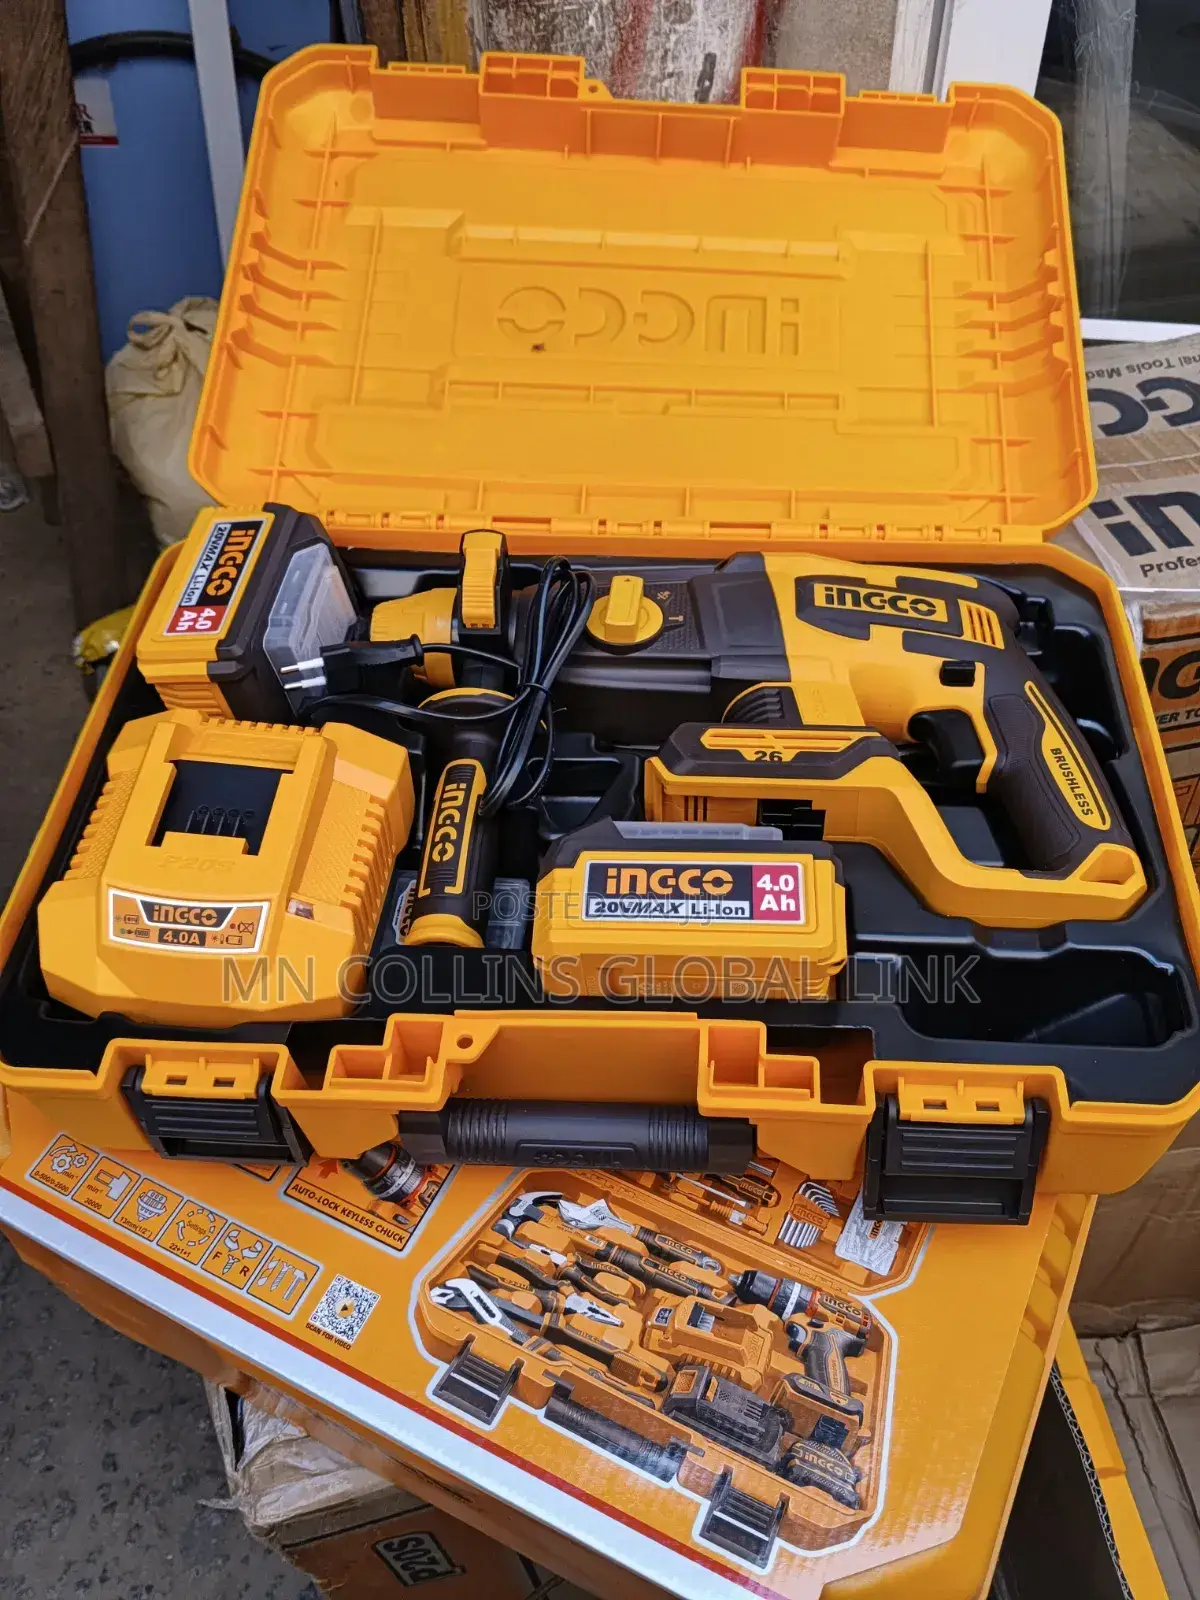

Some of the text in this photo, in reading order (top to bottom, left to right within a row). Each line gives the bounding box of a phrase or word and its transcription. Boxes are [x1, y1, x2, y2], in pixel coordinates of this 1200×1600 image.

[1085, 354, 1200, 380] nal Tools Mad
[1140, 556, 1200, 578] Profe
[176, 610, 198, 631] Ah
[195, 607, 216, 630] 4.0
[754, 750, 783, 762] 26
[1050, 747, 1094, 816] BRUSHLESS
[756, 874, 795, 892] 4.0
[691, 901, 746, 916] Li-Ion
[760, 894, 796, 911] Ah
[162, 930, 200, 945] 4.0A
[291, 1183, 406, 1244] AUTO-LOCK KEYLESS CHUCK
[186, 1220, 207, 1235] Settings
[212, 1251, 222, 1261] F
[239, 1265, 250, 1277] R
[305, 1322, 352, 1351] SCAN FOR VIDEO
